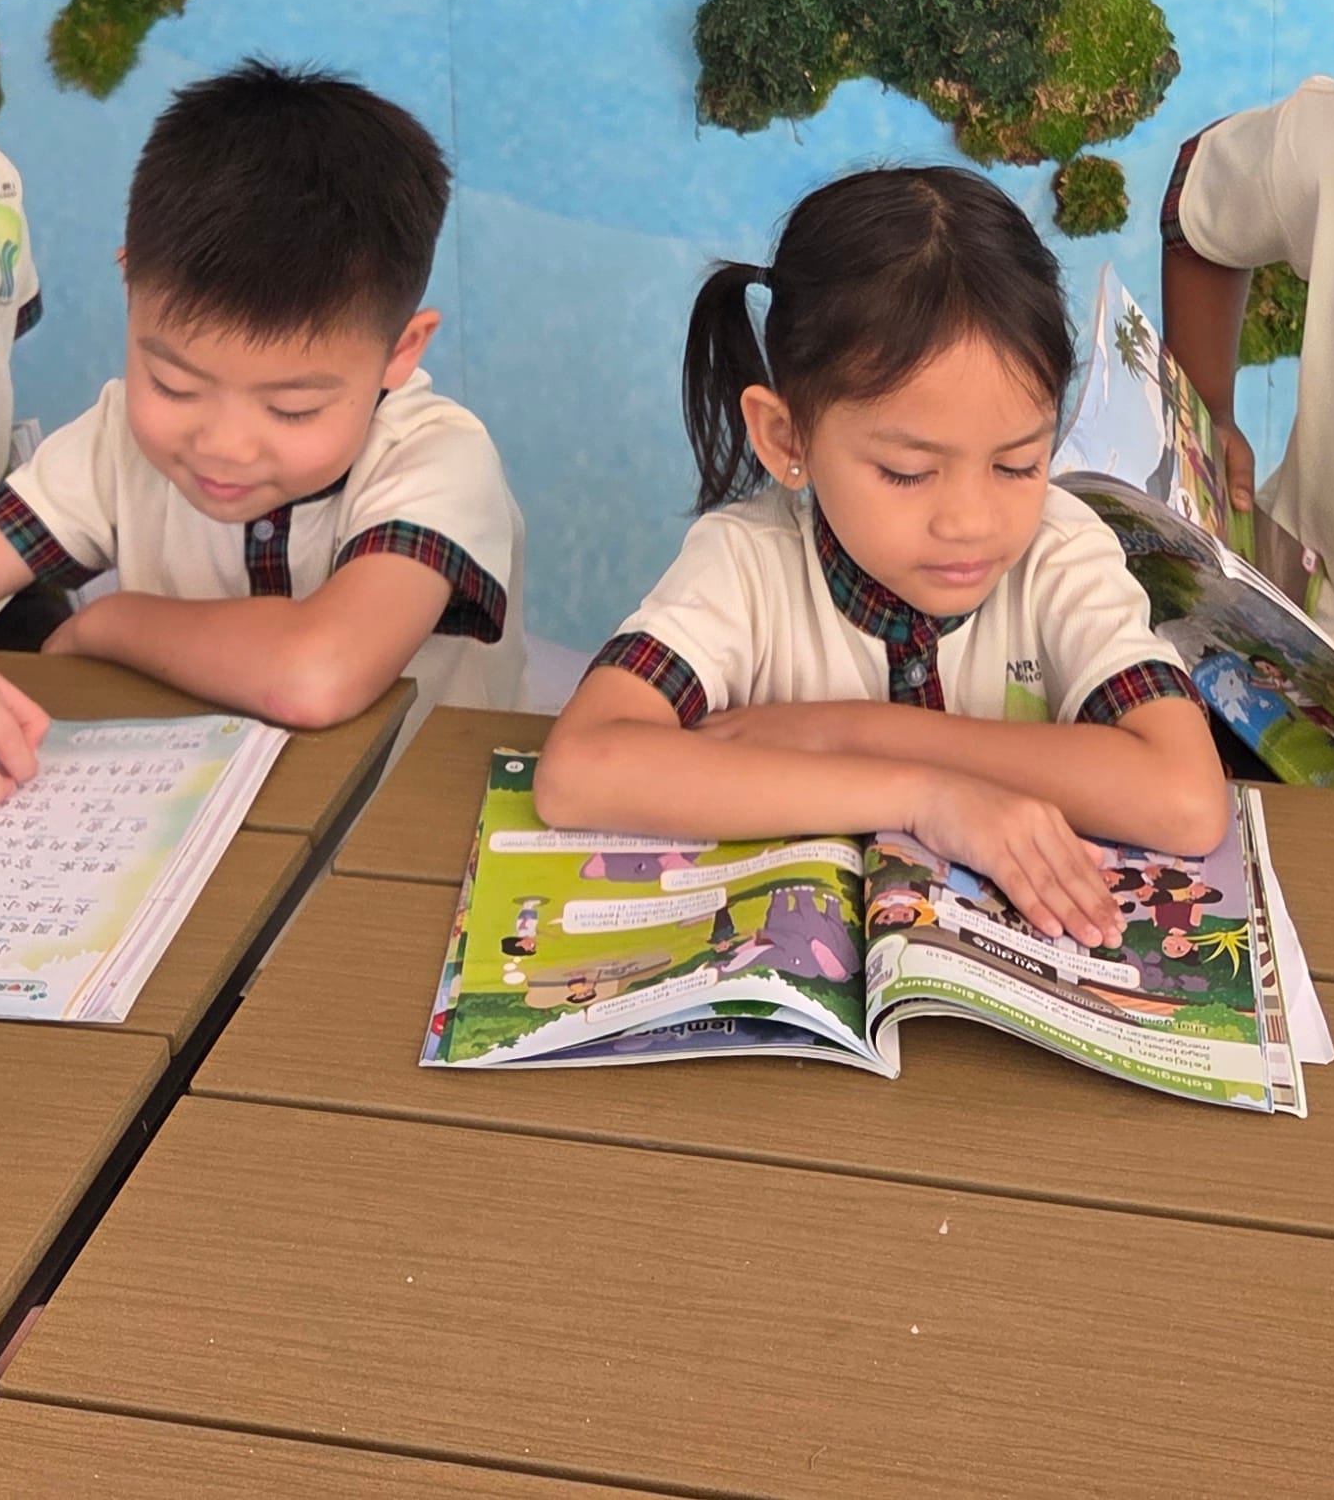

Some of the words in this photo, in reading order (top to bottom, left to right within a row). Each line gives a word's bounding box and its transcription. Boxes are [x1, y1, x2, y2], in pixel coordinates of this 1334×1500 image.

[894, 978, 976, 1000] Singapura
[979, 996, 1036, 1027] Haiwan
[1039, 1023, 1089, 1055] Taman
[1093, 1048, 1114, 1063] Ke
[1136, 1064, 1213, 1091] Bahagian
